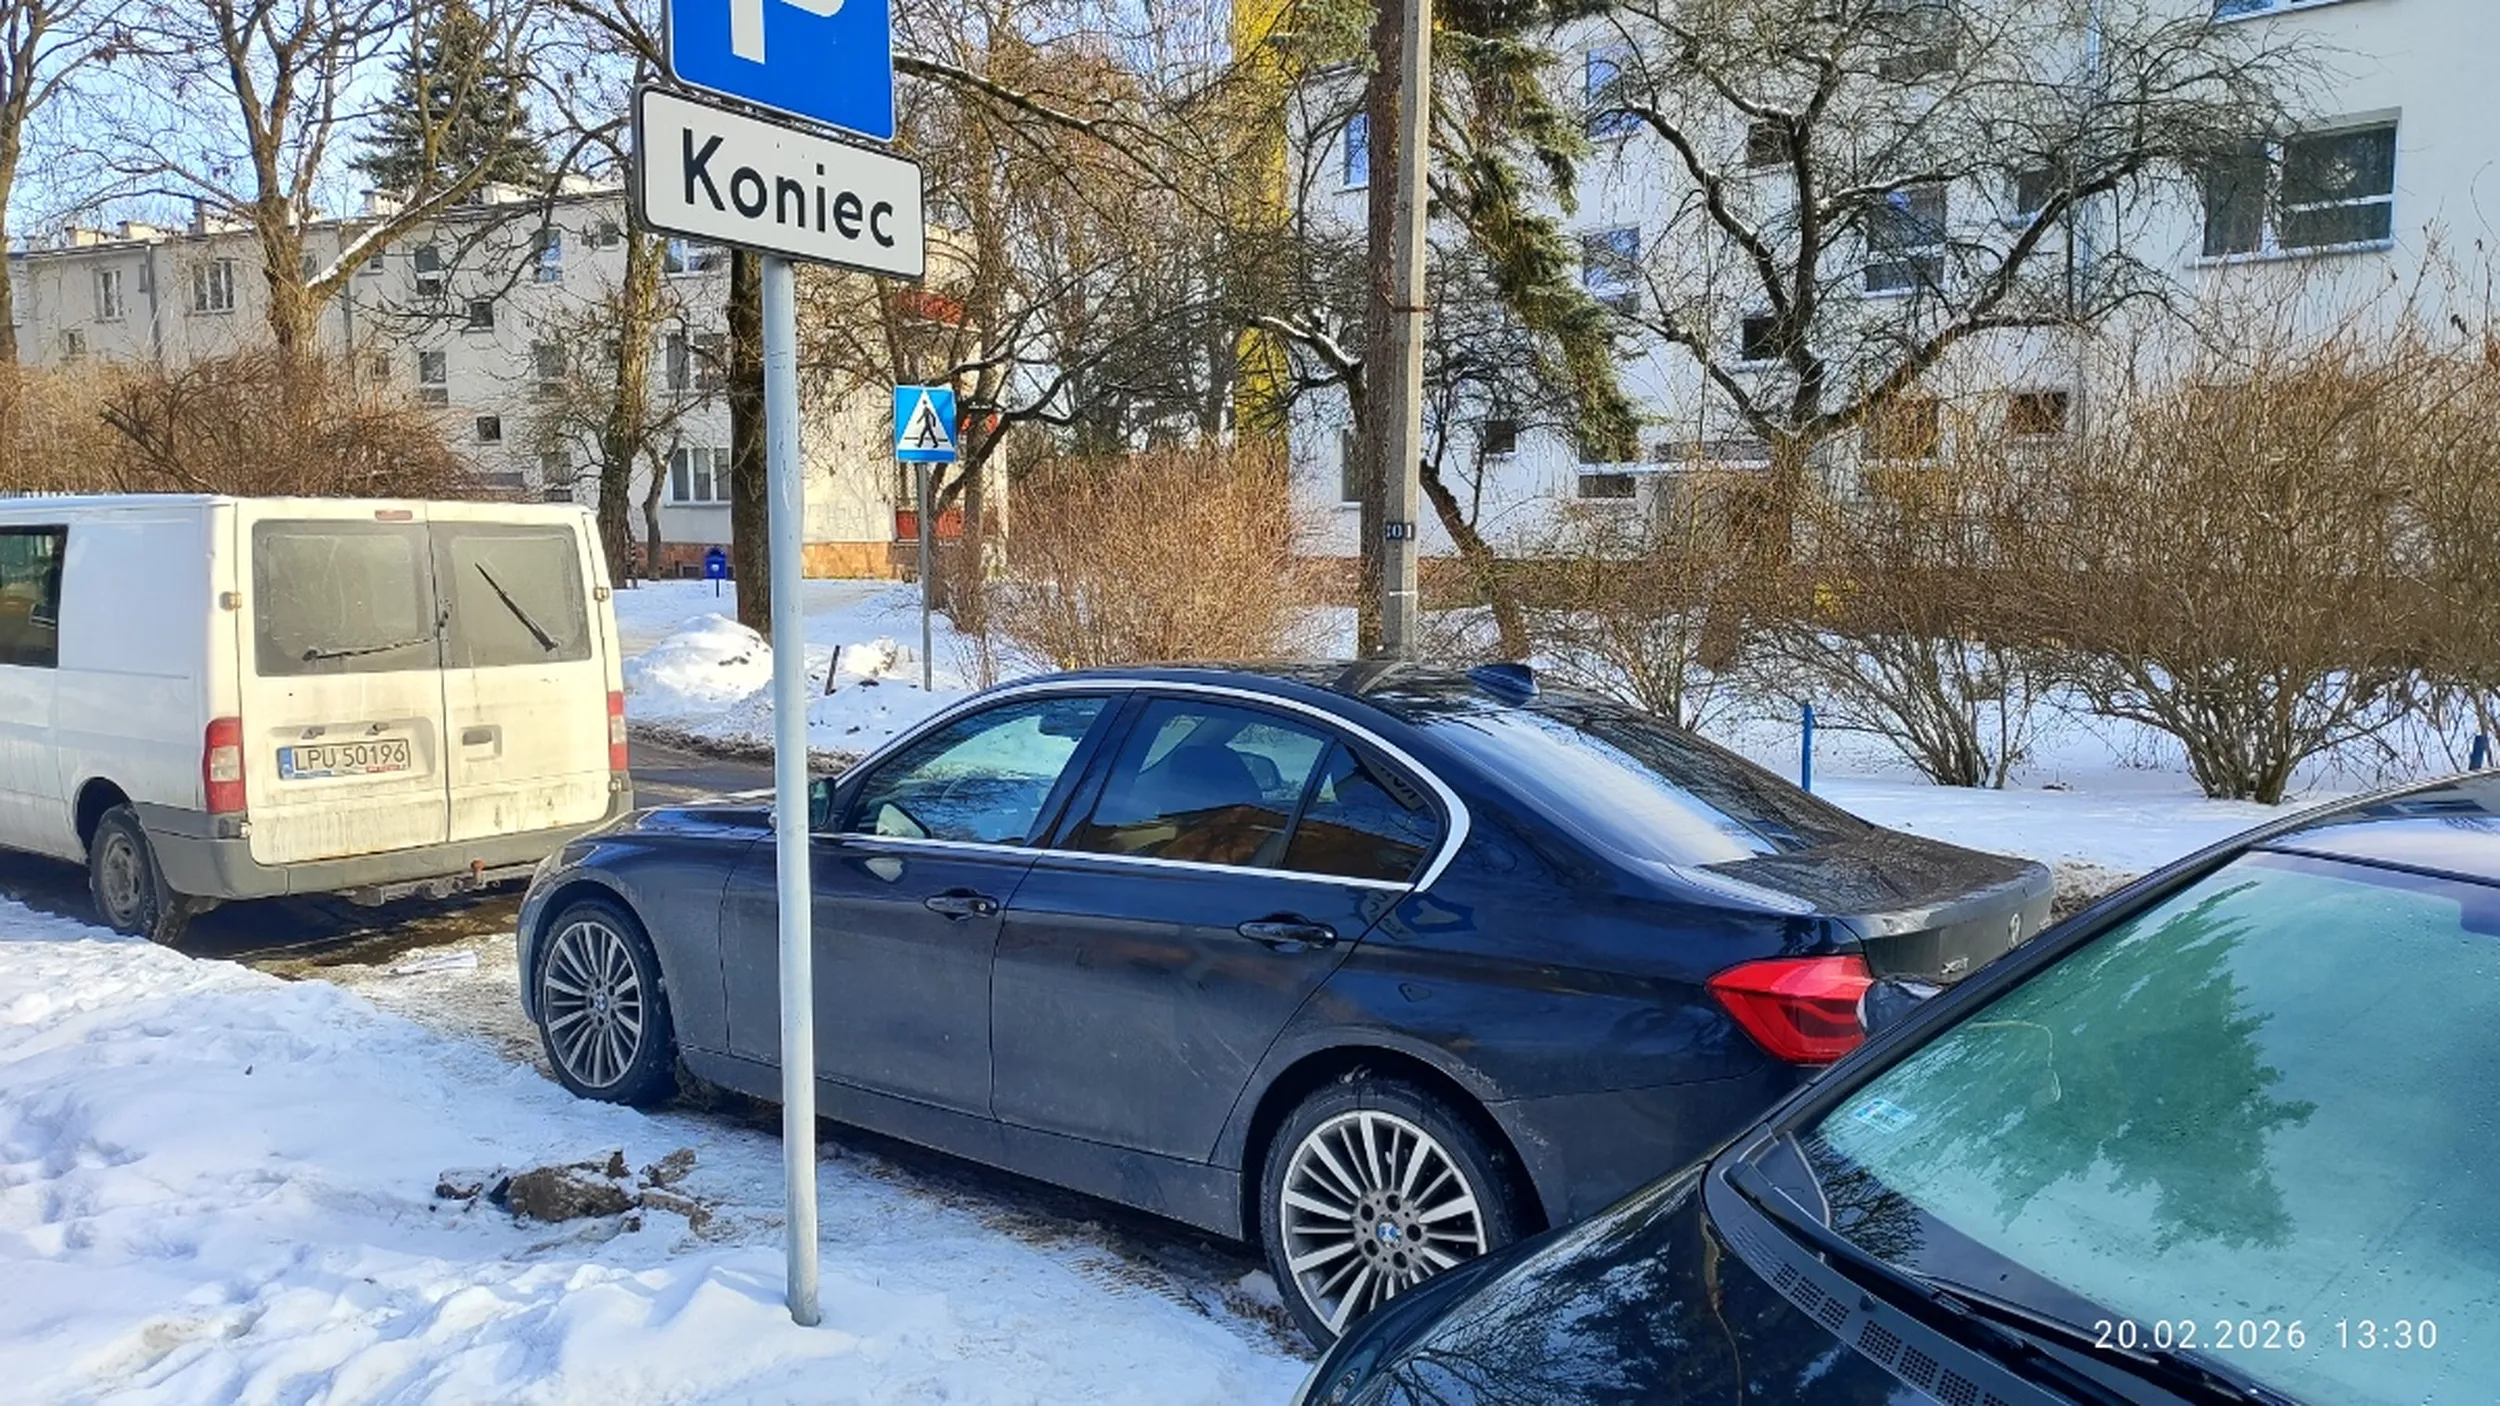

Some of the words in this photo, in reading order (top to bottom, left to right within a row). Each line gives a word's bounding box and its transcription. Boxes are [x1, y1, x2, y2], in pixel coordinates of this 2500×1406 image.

[682, 127, 895, 248] Koniec
[294, 748, 336, 770] LPU
[342, 743, 405, 767] 50196
